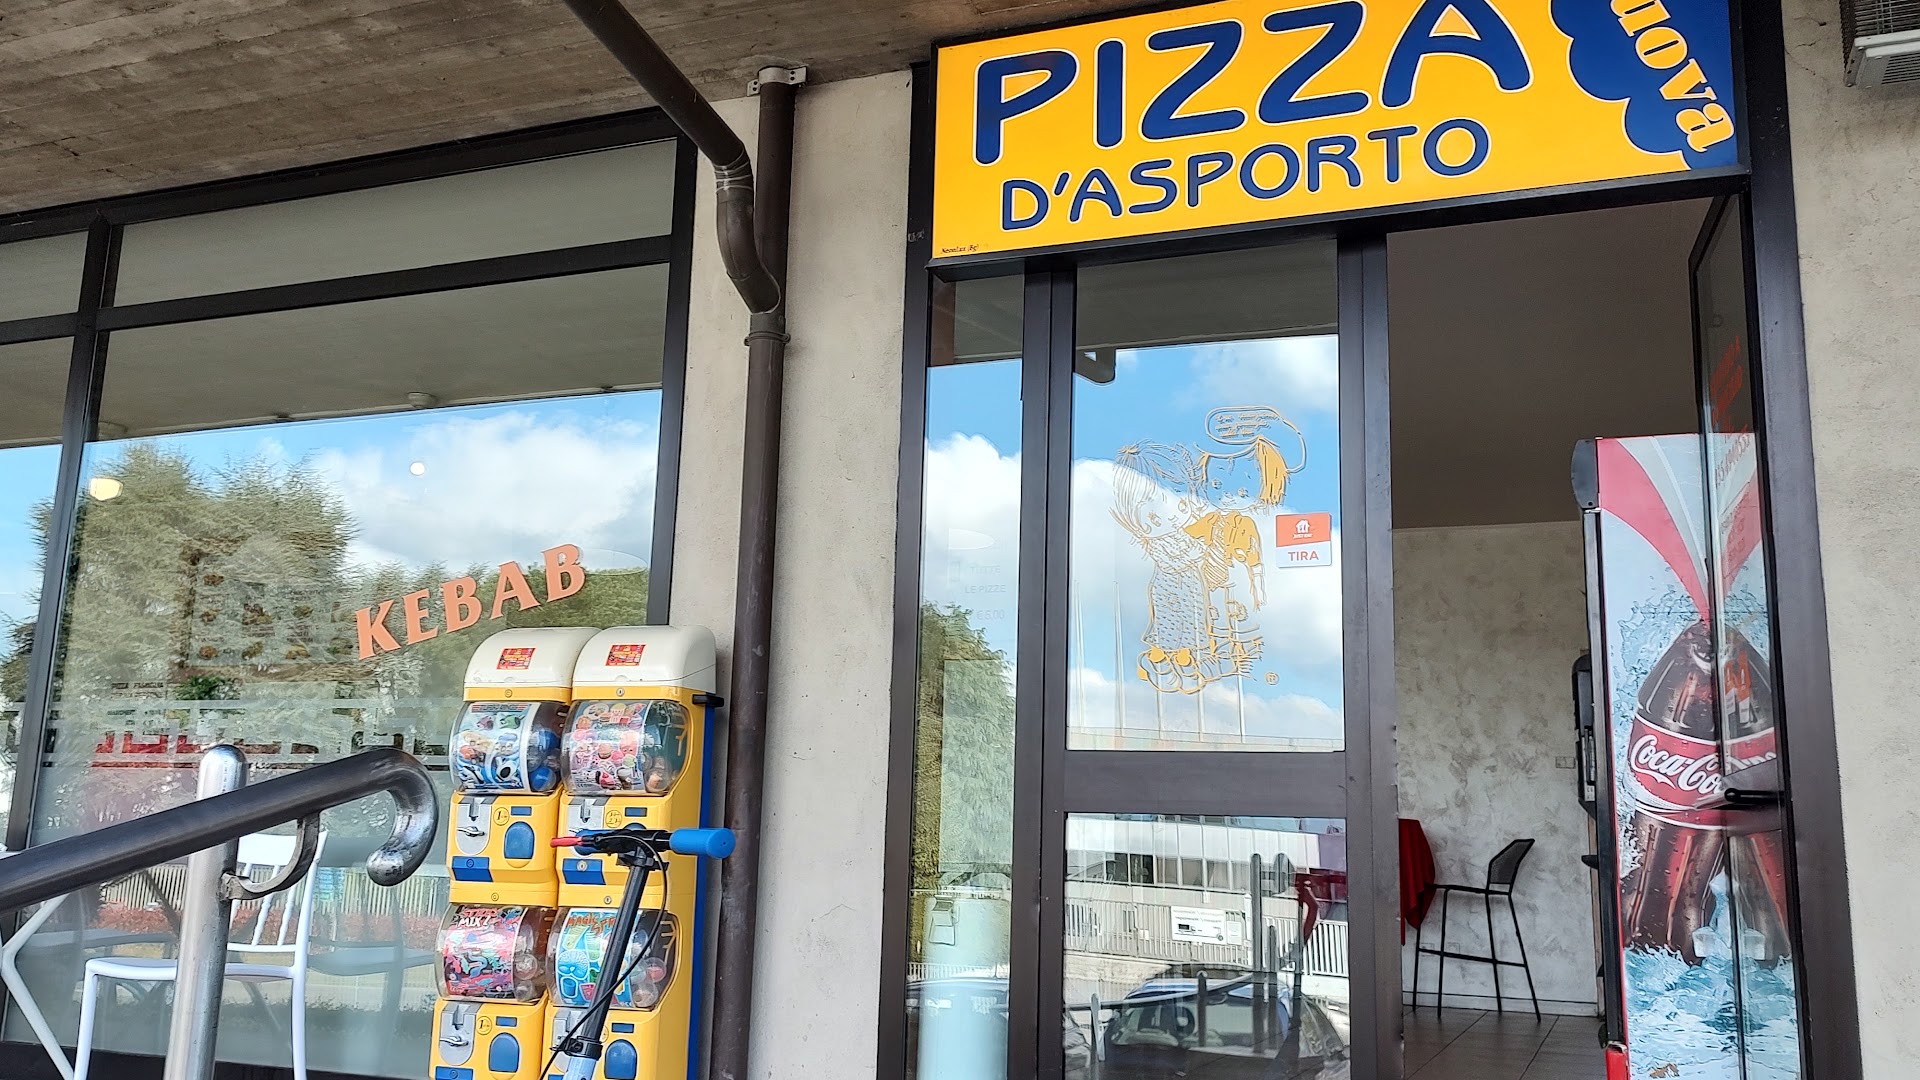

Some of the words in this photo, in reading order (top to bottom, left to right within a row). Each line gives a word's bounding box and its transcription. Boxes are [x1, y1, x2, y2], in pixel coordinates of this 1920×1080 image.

[974, 0, 1534, 166] PIZZA
[1002, 118, 1492, 232] D'ASPORTO
[356, 543, 586, 660] KEBAB
[1287, 550, 1319, 562] TIRA
[1630, 734, 1721, 795] Coca-Co
